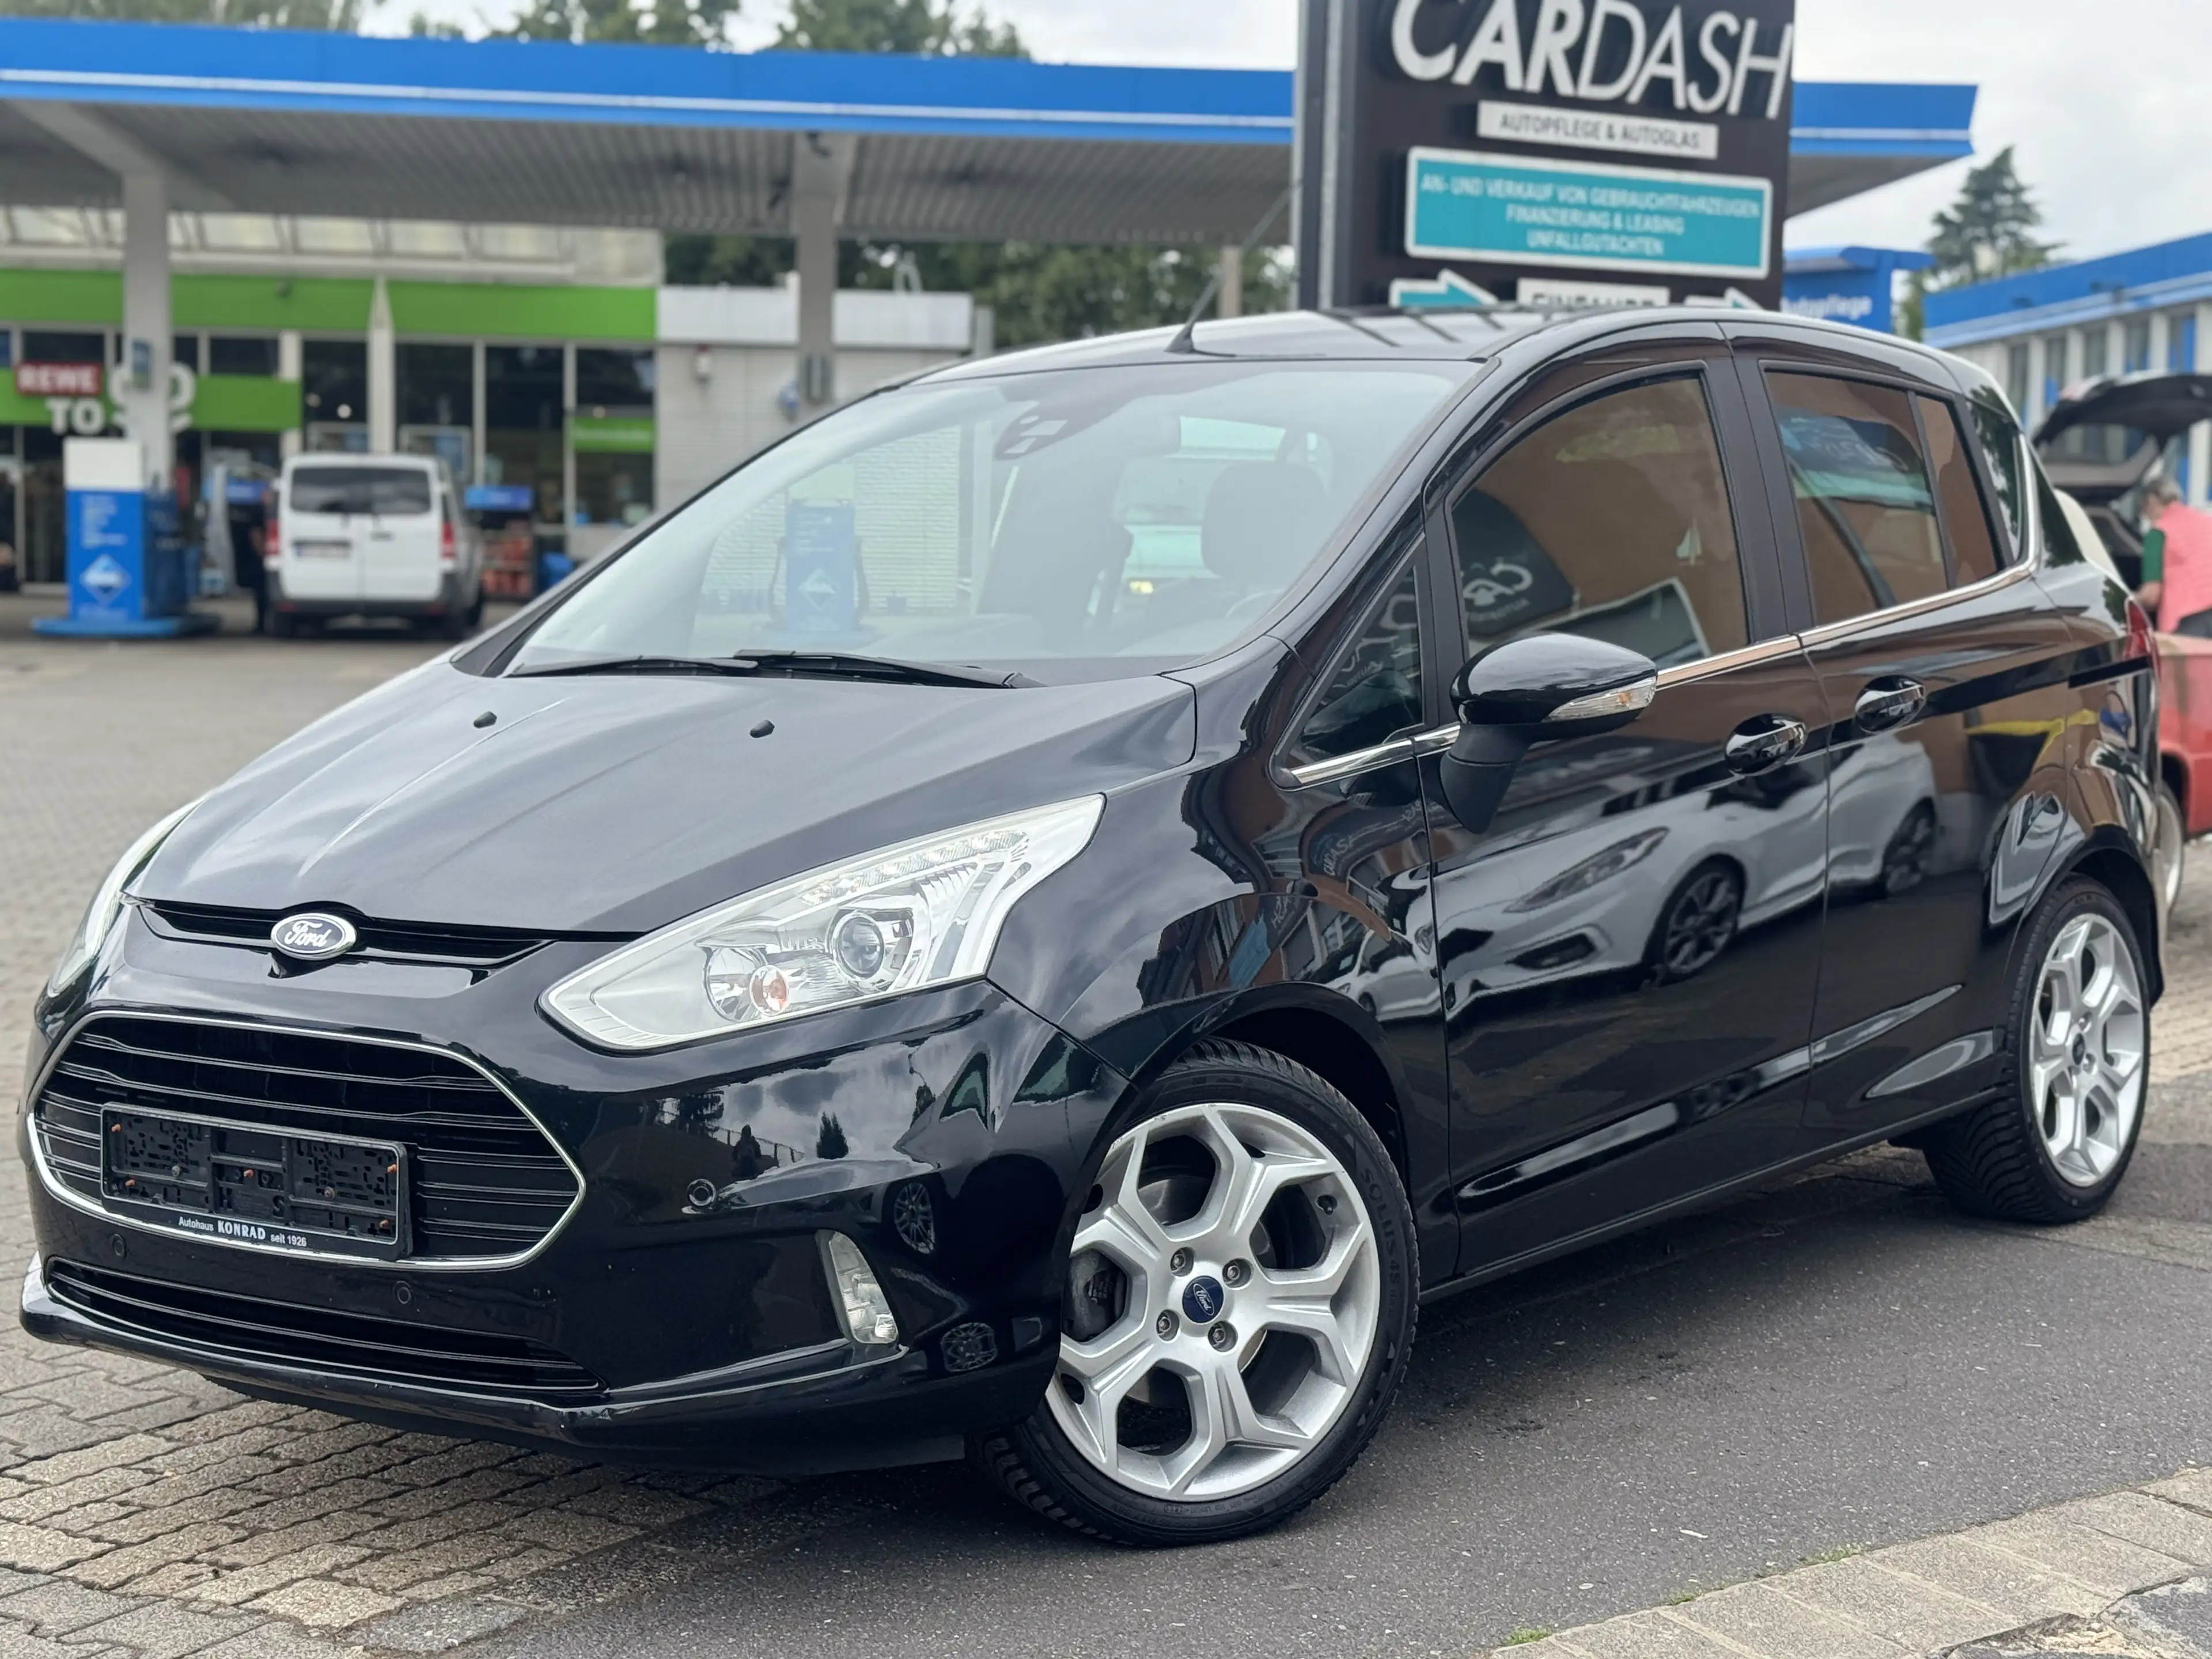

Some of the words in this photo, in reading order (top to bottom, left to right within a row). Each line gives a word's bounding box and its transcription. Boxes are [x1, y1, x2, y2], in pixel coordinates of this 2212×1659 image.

[1391, 0, 1793, 119] CARDASH
[1500, 112, 1603, 142] AUTOPFLEGE
[1605, 124, 1616, 142] &
[1622, 124, 1700, 150] AUTOGLAS
[1421, 173, 1449, 193] AN-
[1449, 176, 1483, 197] UND
[1484, 178, 1554, 202] VERKAUF
[1557, 184, 1588, 204] VON
[1505, 203, 1610, 229] FINANZIERUNG
[1613, 211, 1622, 230] &
[1626, 214, 1685, 235] LEASING
[18, 364, 95, 393] REWE
[45, 397, 105, 435] TO
[283, 919, 333, 948] Ford
[1361, 1167, 1397, 1255] SOLUS
[178, 1215, 214, 1232] Autohaus
[217, 1219, 266, 1241] KONRAD
[270, 1233, 286, 1244] seit
[287, 1234, 308, 1247] 1926
[1195, 1289, 1212, 1312] Ford
